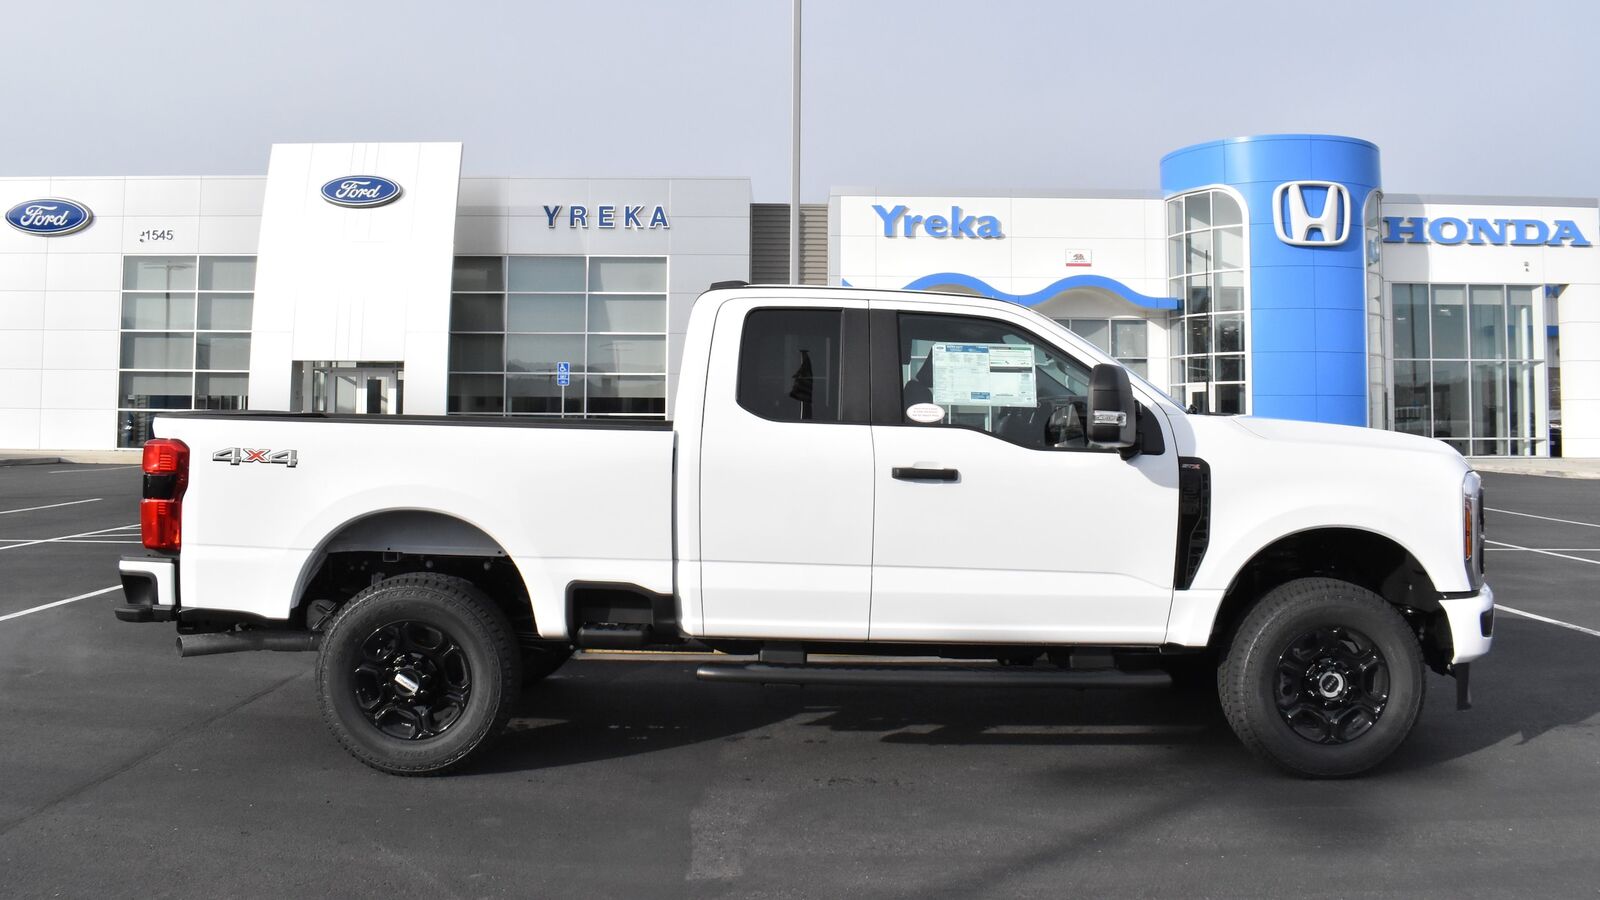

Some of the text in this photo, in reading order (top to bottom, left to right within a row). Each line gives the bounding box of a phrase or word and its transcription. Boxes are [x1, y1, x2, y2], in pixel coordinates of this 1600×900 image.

[336, 180, 382, 198] Ford
[20, 205, 70, 226] Ford
[543, 204, 670, 229] YREKA
[871, 204, 1005, 239] Yreka
[145, 229, 174, 241] 1545
[1383, 216, 1593, 247] HONDA
